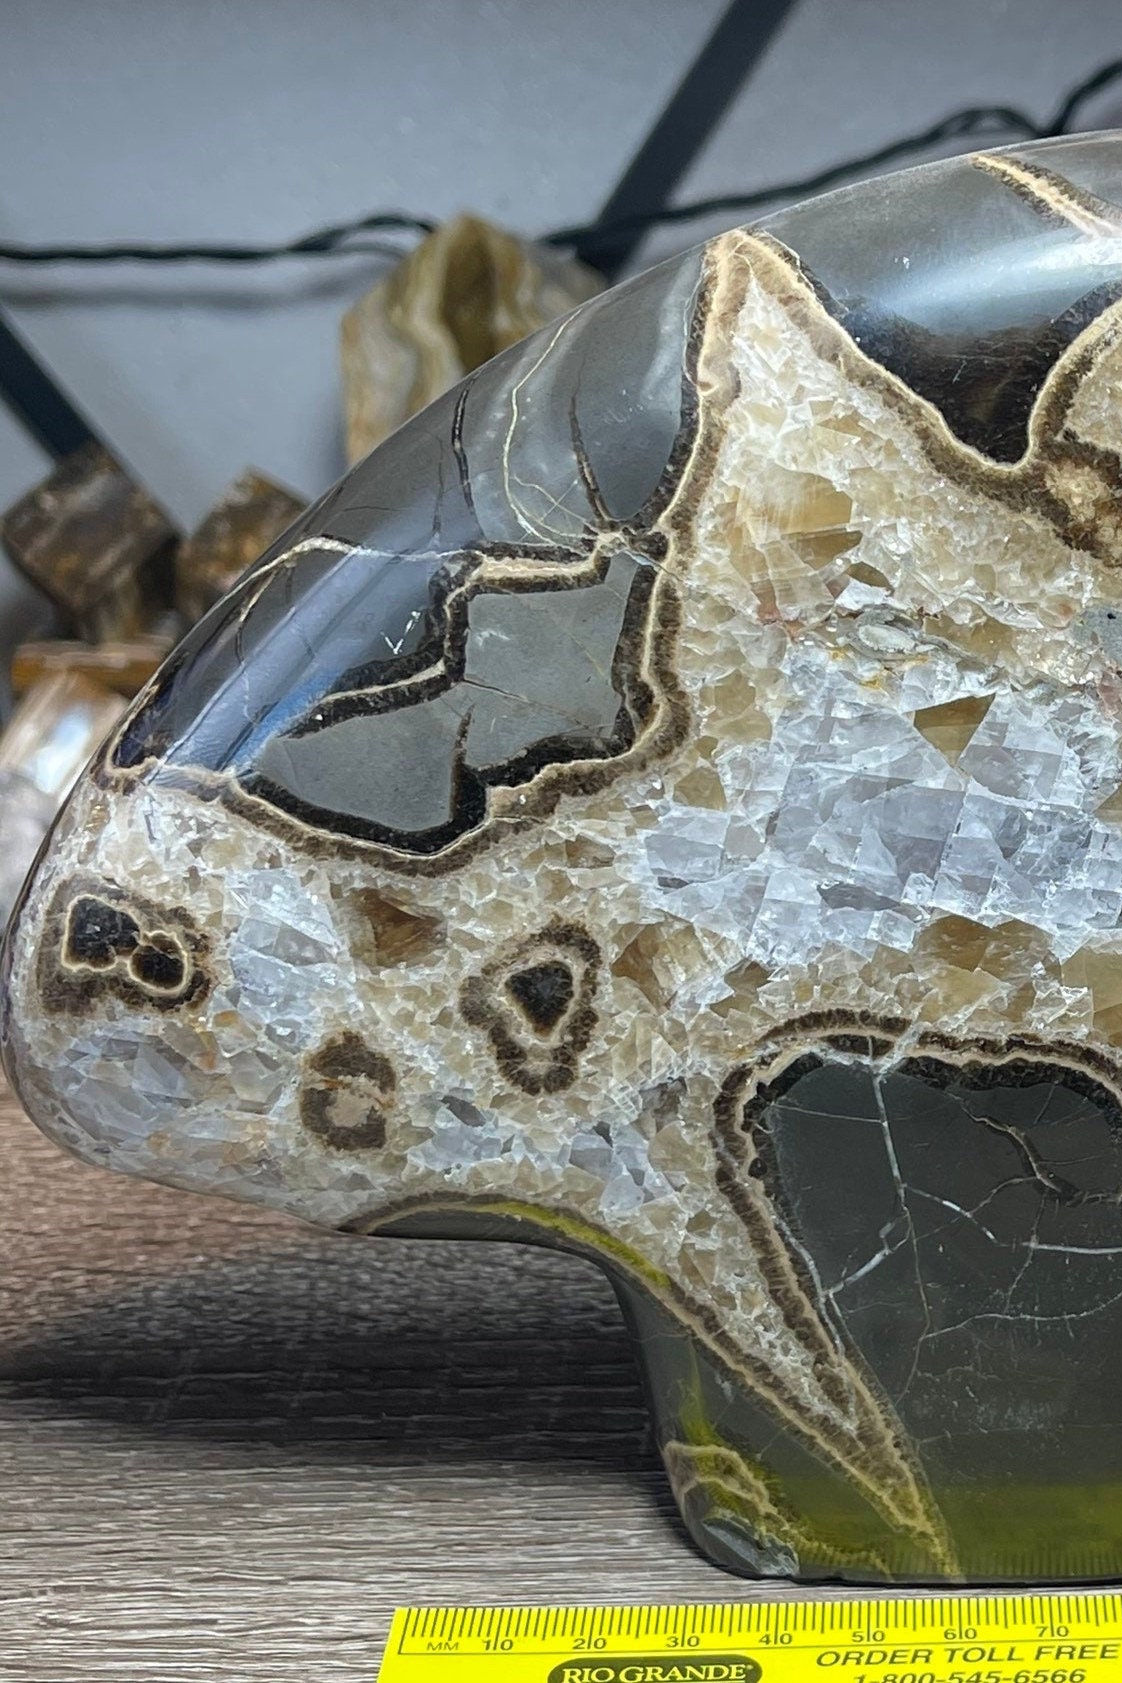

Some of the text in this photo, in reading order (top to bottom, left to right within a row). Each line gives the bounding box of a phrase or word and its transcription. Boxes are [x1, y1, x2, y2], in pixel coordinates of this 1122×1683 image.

[426, 1641, 459, 1651] MM
[483, 1639, 514, 1651] 10
[572, 1637, 607, 1649] 20
[666, 1634, 700, 1648] 30
[759, 1632, 793, 1645] 40
[852, 1630, 885, 1642] 50
[944, 1628, 977, 1640] 60
[1036, 1626, 1069, 1638] 70
[816, 1643, 1121, 1667] ORDER TOLL FREE
[561, 1664, 746, 1683] RIO GRANDE
